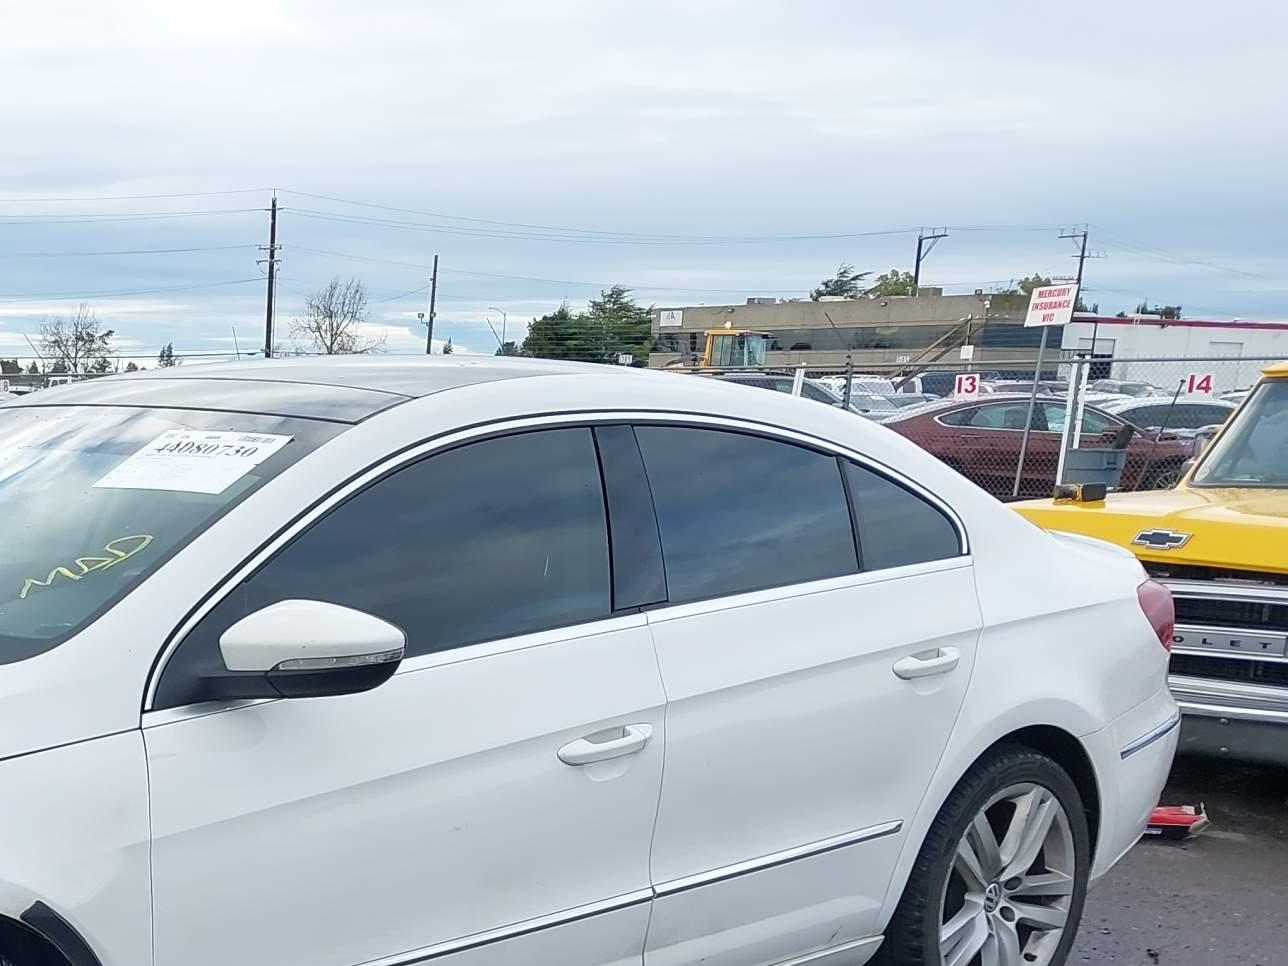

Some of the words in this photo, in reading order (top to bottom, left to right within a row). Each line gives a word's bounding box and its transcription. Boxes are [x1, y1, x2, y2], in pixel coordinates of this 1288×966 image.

[1038, 287, 1072, 299] MERCURY
[1032, 299, 1072, 312] INSURANCE
[1042, 313, 1055, 322] VIC
[3, 380, 9, 393] 8
[957, 375, 977, 394] 13
[1188, 374, 1212, 394] 14
[154, 440, 259, 458] 44080730
